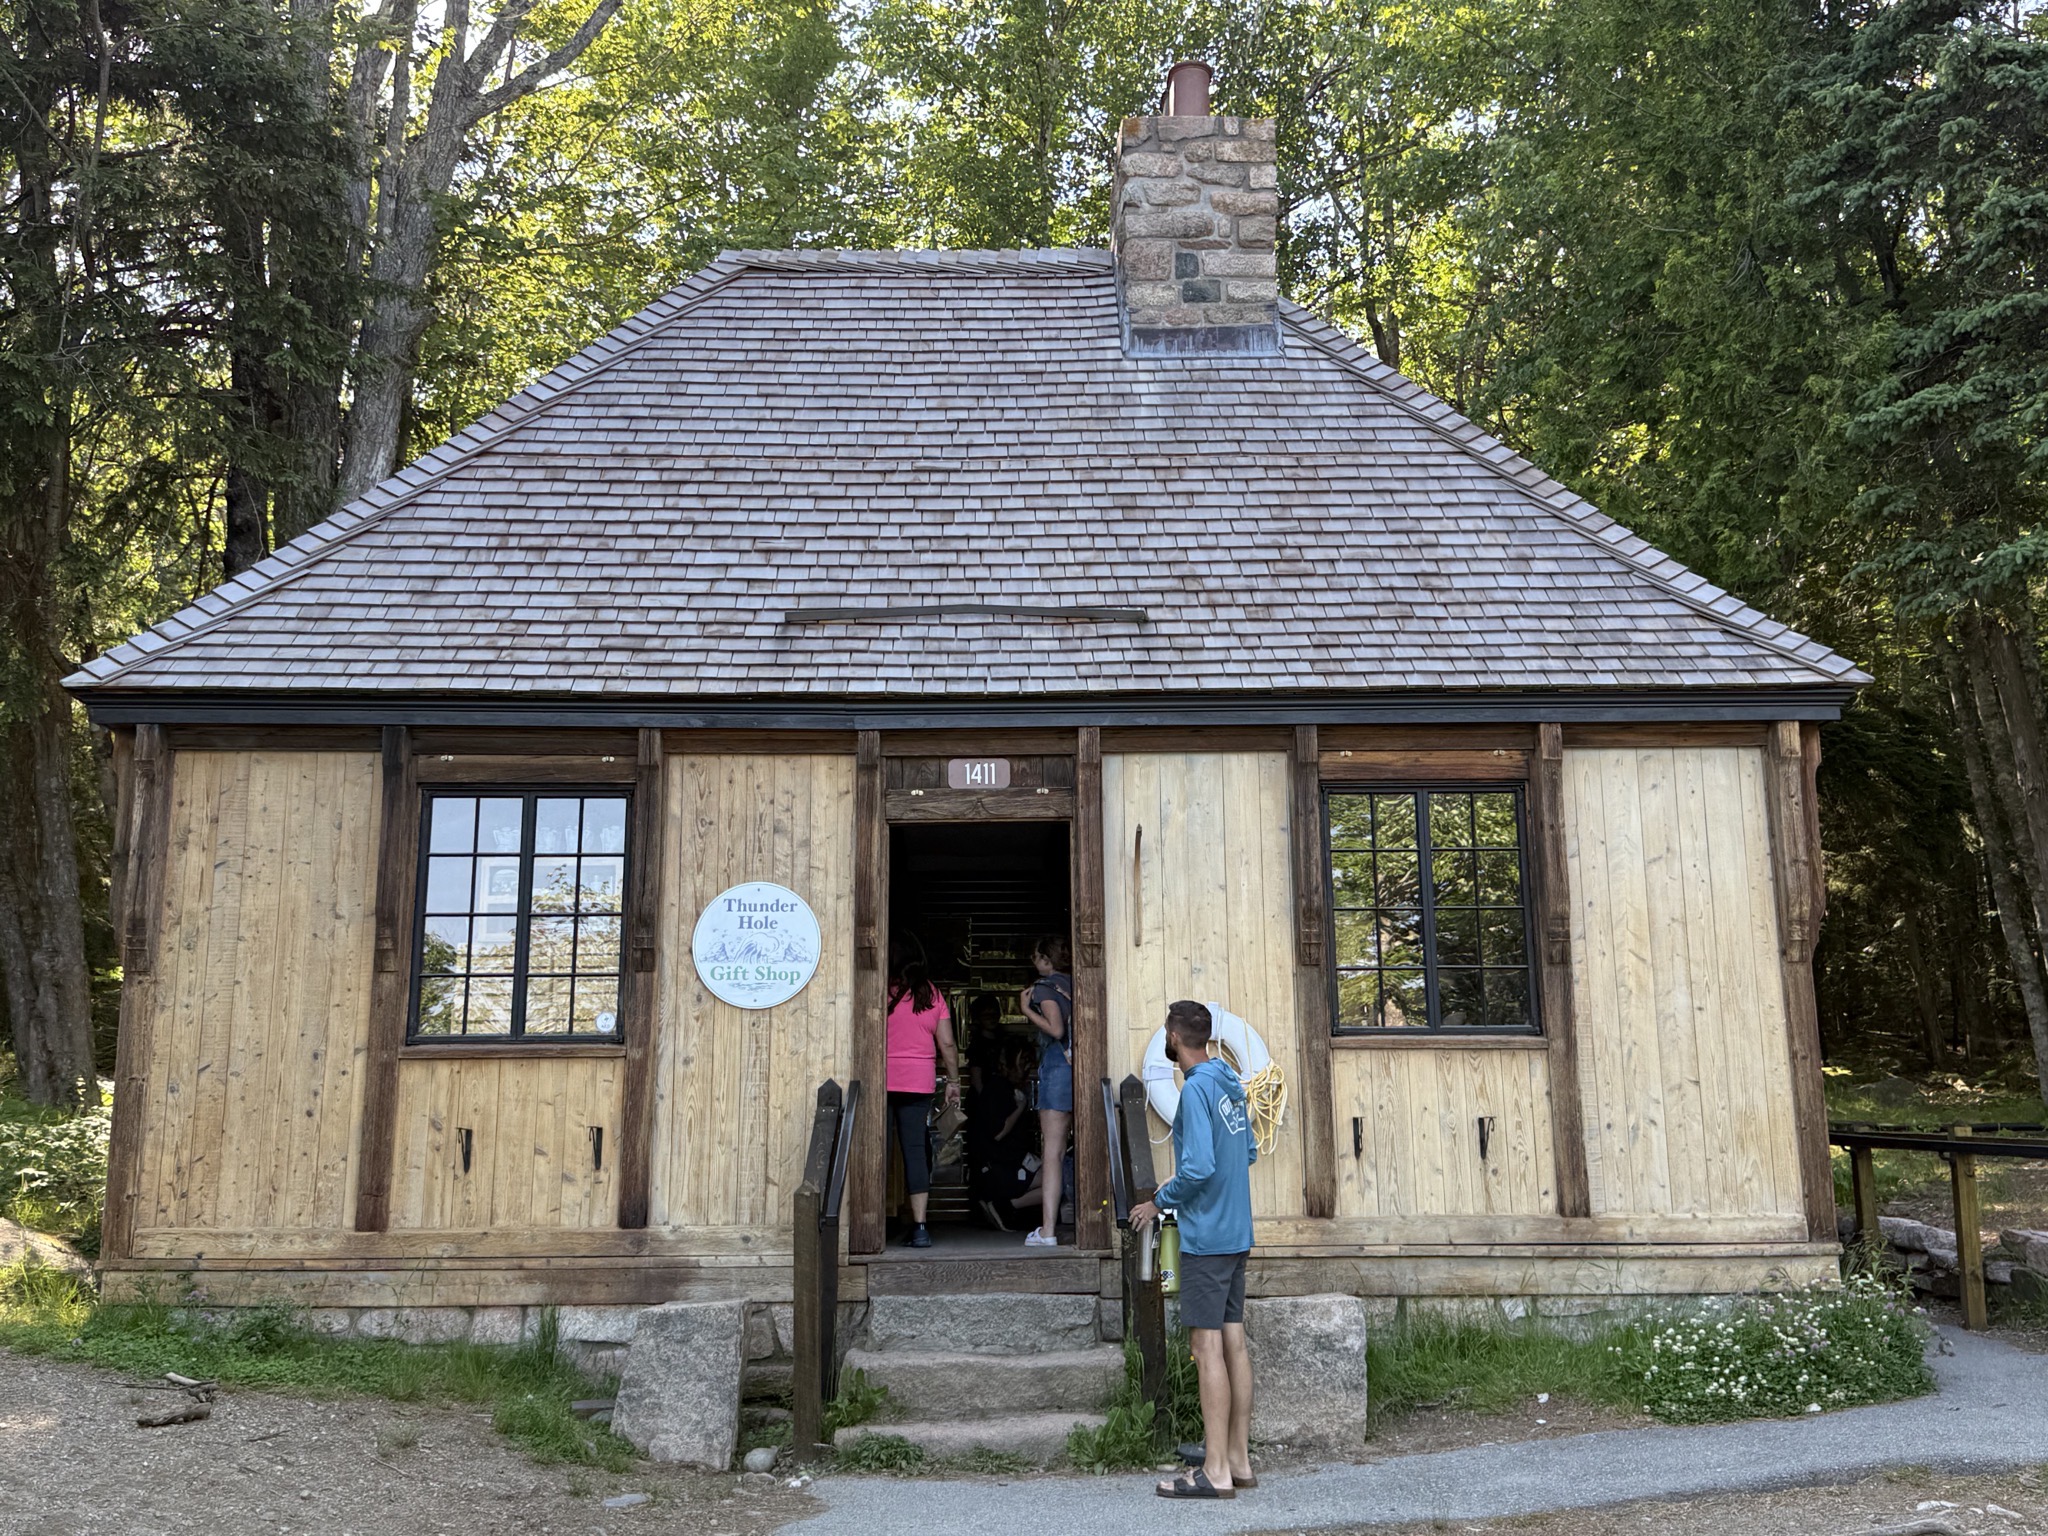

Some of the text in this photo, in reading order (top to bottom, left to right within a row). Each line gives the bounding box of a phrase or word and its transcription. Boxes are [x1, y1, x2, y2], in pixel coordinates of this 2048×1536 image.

[964, 762, 996, 785] 1411
[723, 898, 798, 912] Thunder
[738, 915, 778, 930] Hole
[710, 965, 801, 985] Gift Shop
